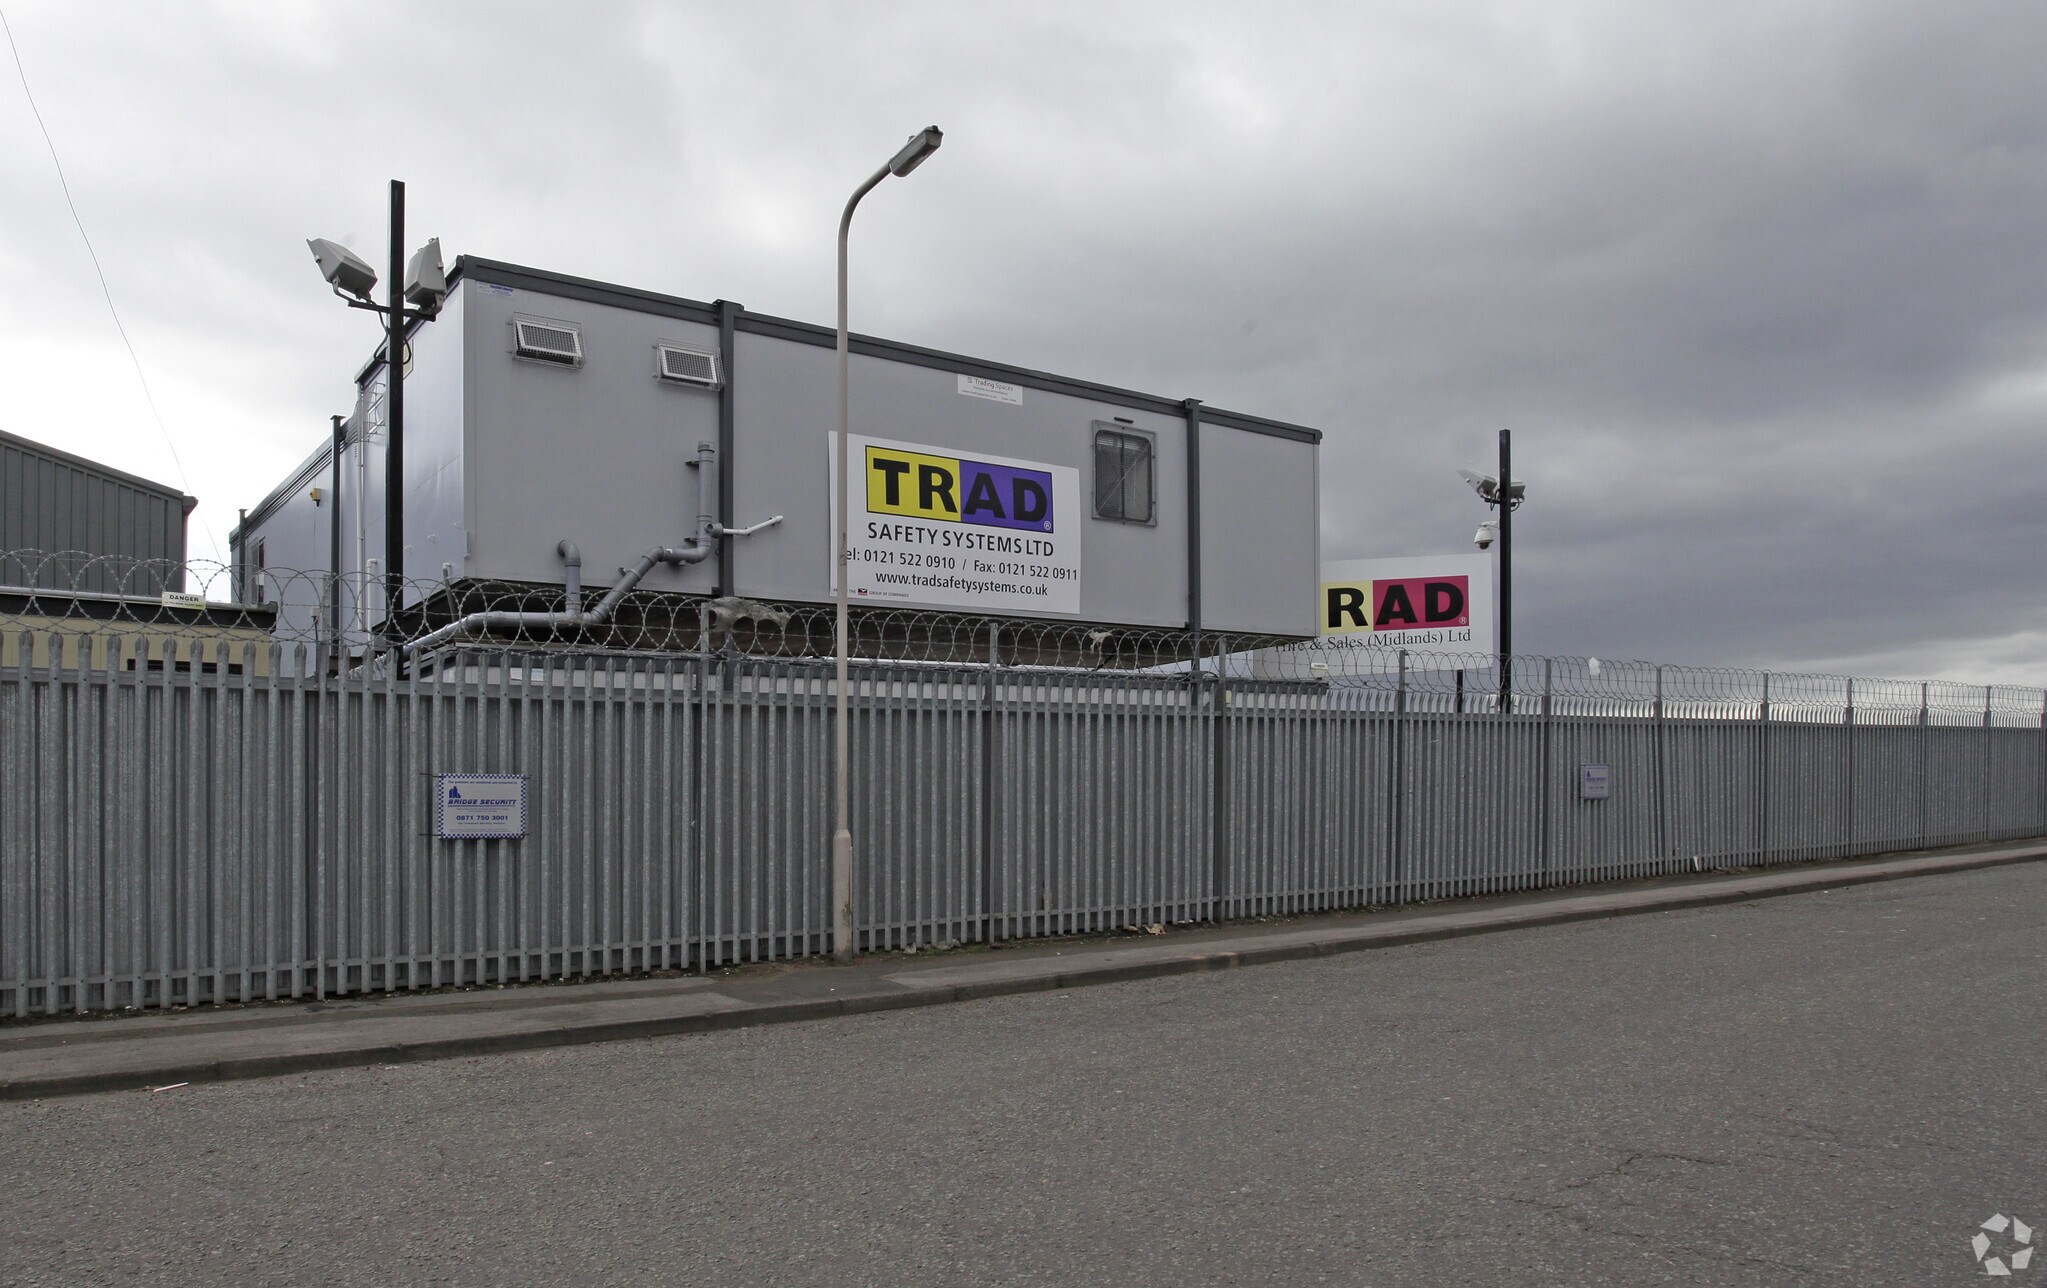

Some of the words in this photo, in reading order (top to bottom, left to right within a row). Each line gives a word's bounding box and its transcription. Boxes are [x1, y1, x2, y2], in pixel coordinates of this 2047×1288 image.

[975, 378, 995, 389] Trading
[873, 457, 1048, 522] TRAD
[868, 522, 938, 545] SAFETY
[942, 530, 1022, 554] SYSTEMS
[1026, 539, 1054, 557] LTD
[847, 547, 860, 561] el:
[864, 549, 894, 564] 0121
[900, 552, 922, 567] 522
[926, 555, 955, 570] 0910
[962, 558, 967, 570] /
[974, 560, 996, 573] Fax:
[999, 562, 1025, 576] 0121
[1030, 565, 1049, 578] 522
[1052, 567, 1077, 581] 0911
[875, 572, 1048, 596] www.tradsafetysystems.co.uk
[1328, 582, 1464, 628] RAD
[1327, 636, 1363, 649] Sales
[1367, 631, 1443, 648] (Midlands)
[1448, 629, 1471, 642] Ltd
